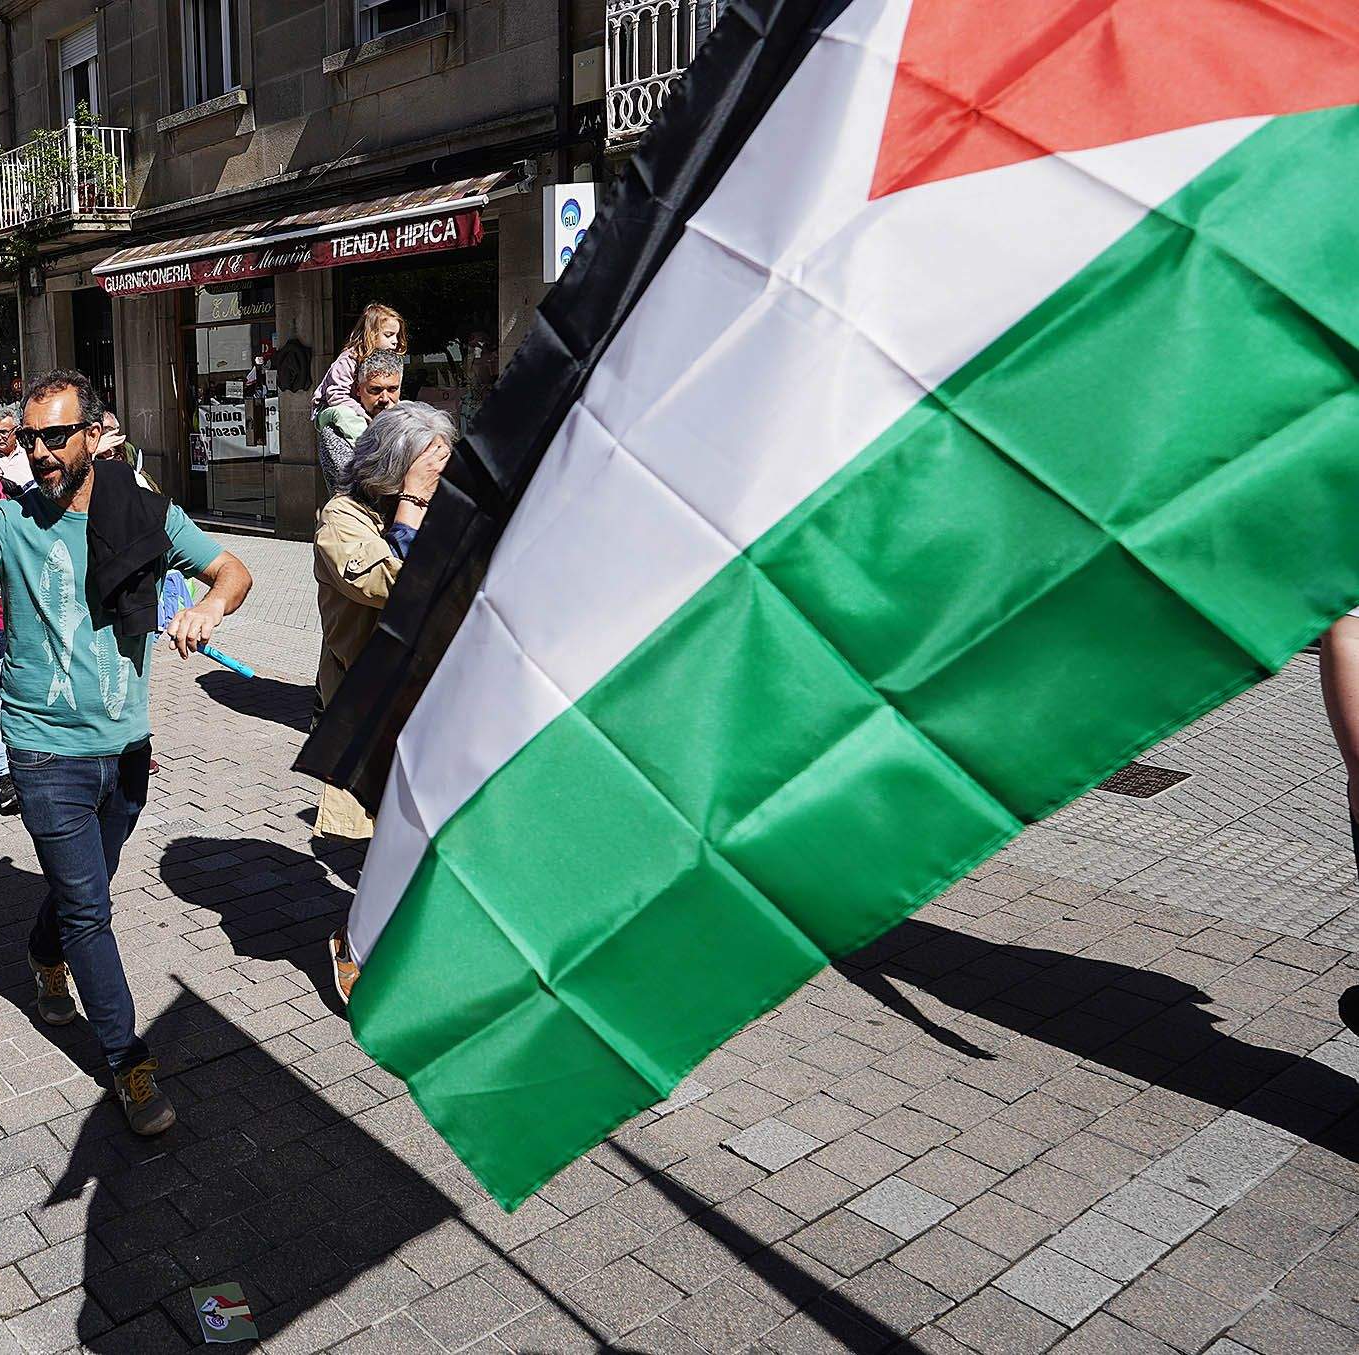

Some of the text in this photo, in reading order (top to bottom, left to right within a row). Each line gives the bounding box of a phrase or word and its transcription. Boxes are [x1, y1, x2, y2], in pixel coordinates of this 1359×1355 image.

[564, 217, 576, 226] GLU
[104, 263, 192, 293] GUARNICIONERIA
[250, 244, 313, 271] Mouriño
[331, 229, 390, 259] TIENDA
[396, 217, 457, 249] HIPICA
